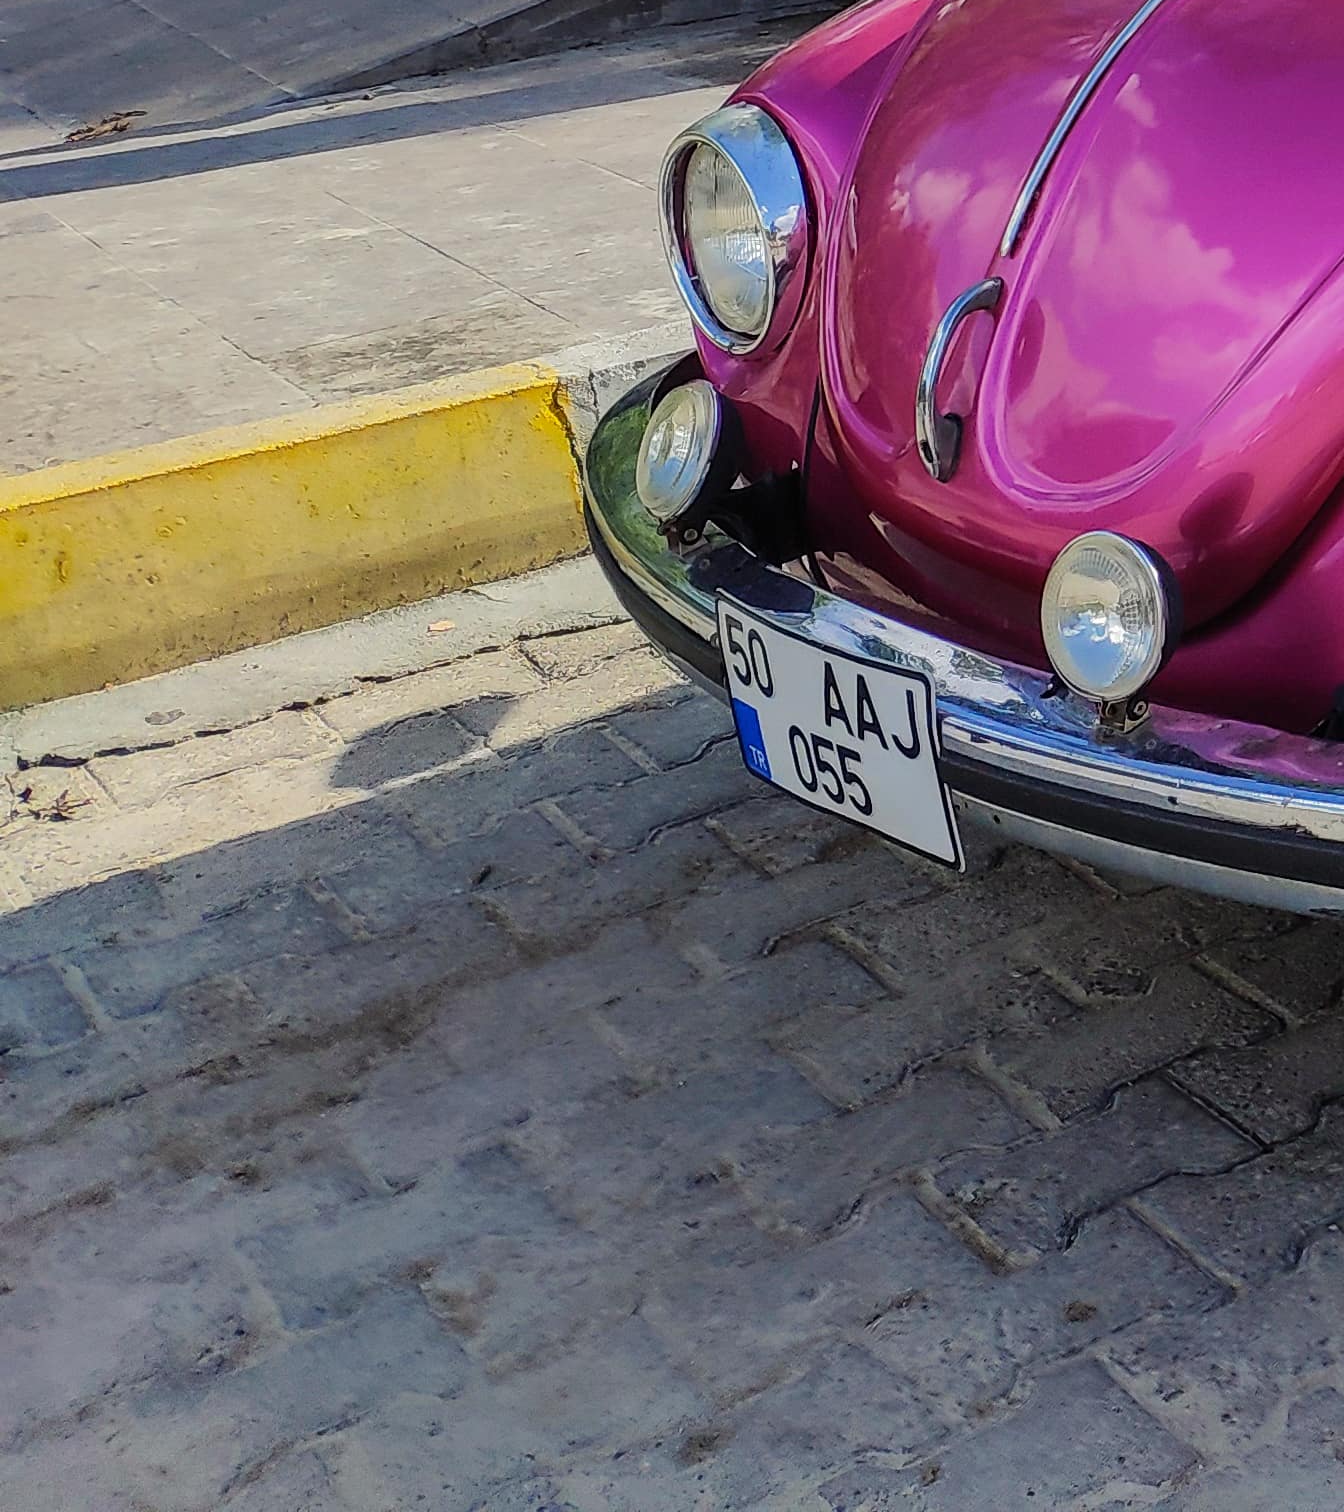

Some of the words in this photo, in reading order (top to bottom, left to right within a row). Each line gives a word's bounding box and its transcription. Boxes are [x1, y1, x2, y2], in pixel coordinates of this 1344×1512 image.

[725, 613, 774, 698] 50
[824, 661, 920, 759] AAJ
[749, 745, 768, 770] TR
[789, 725, 873, 816] 055
